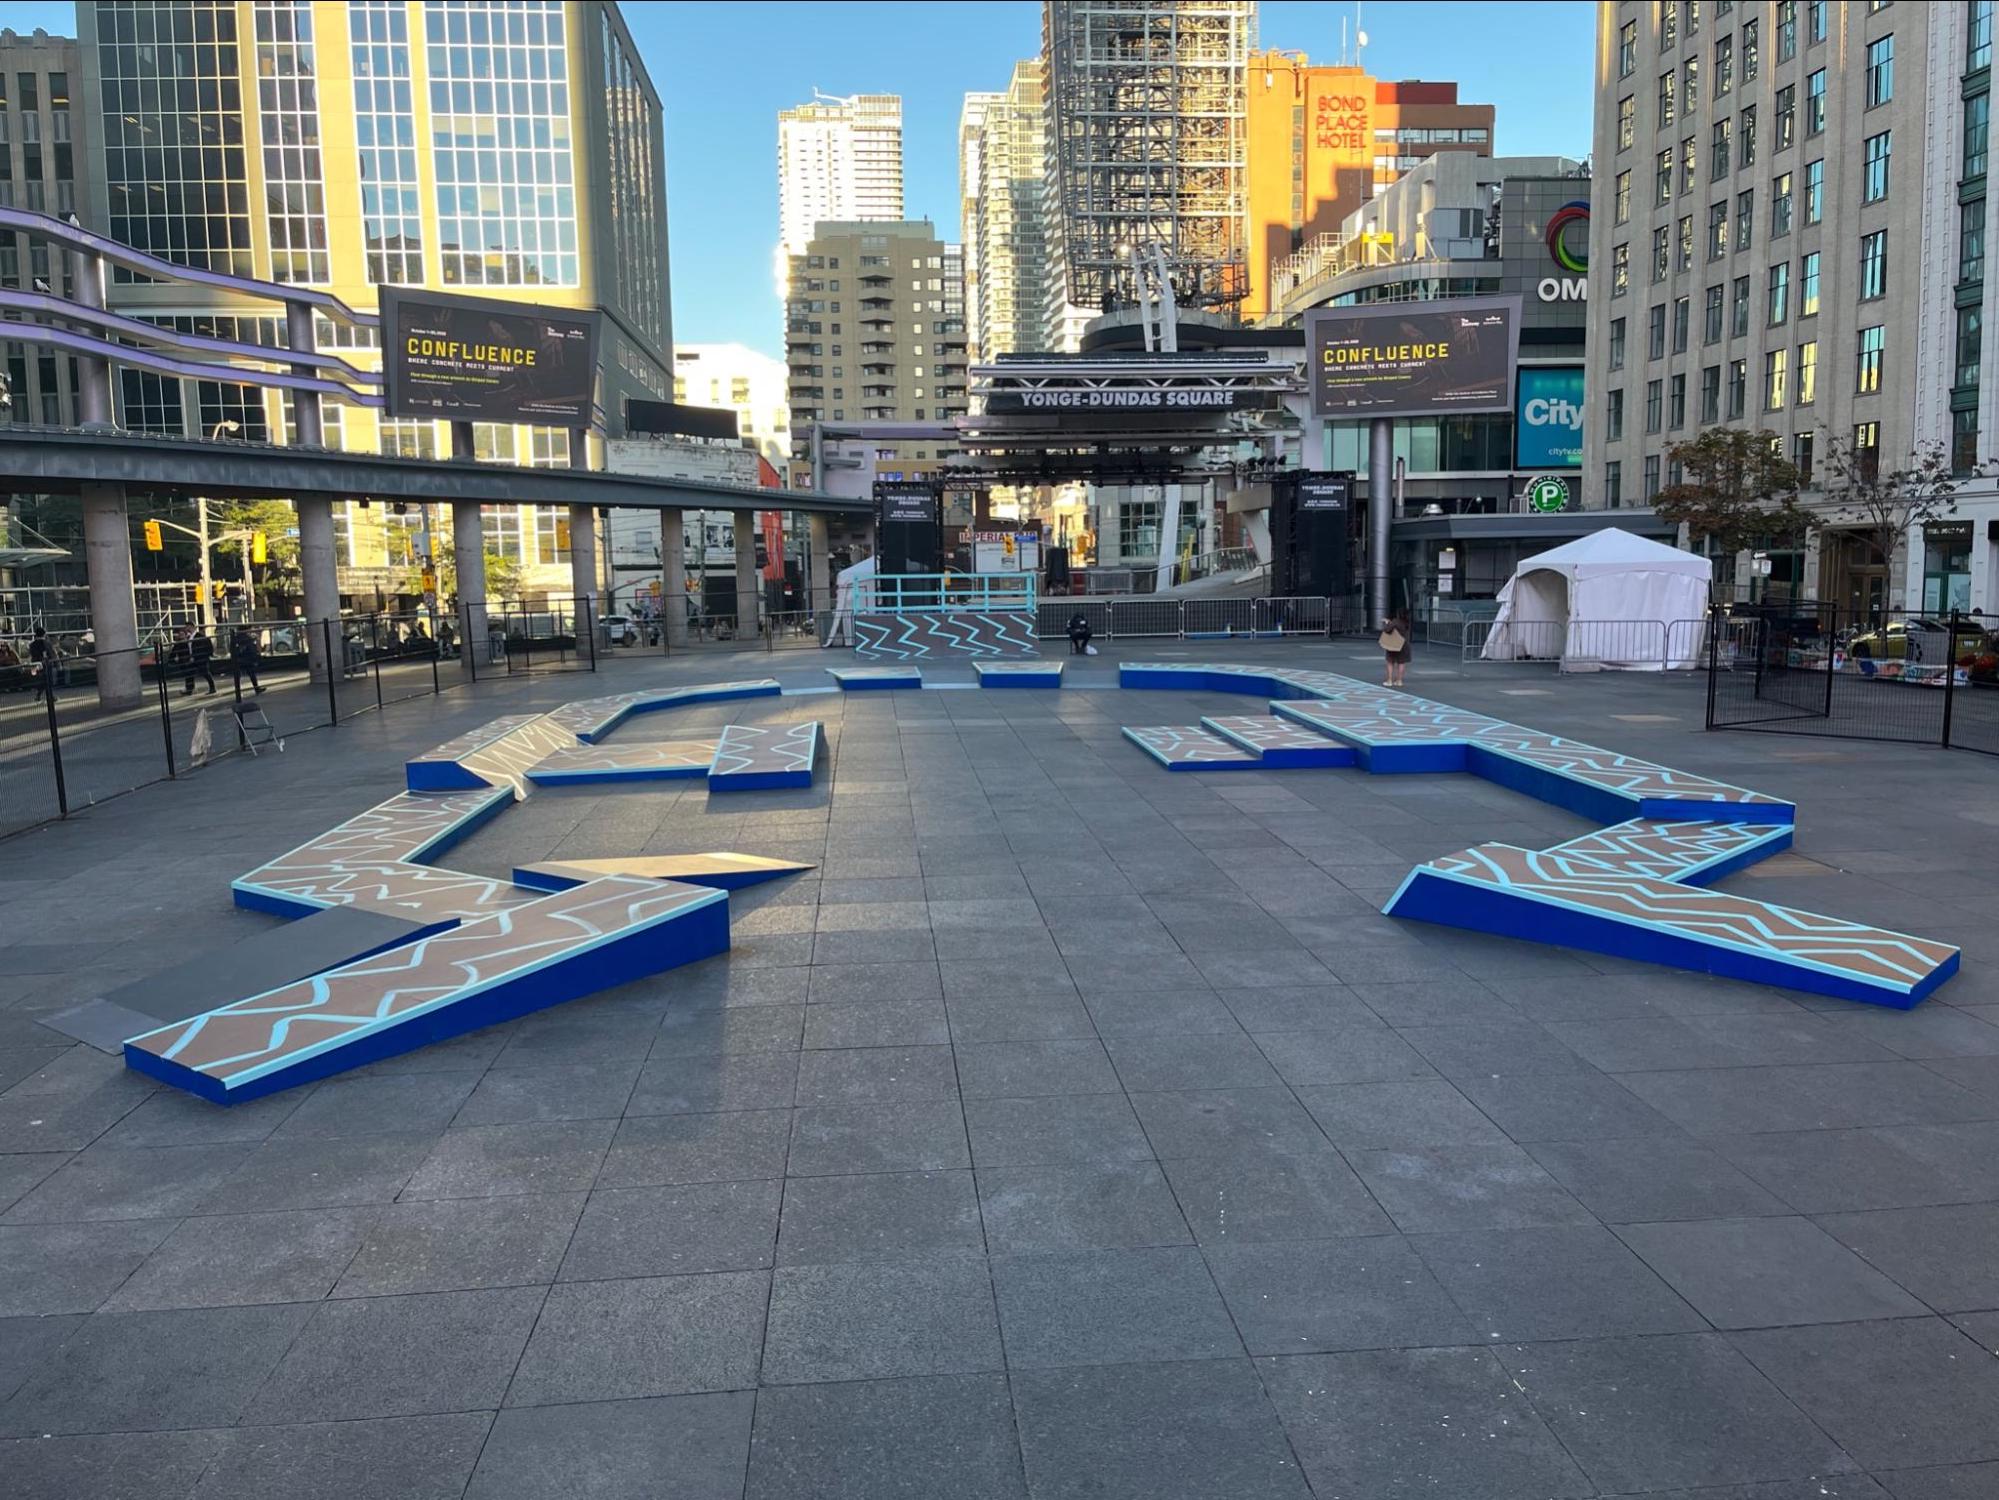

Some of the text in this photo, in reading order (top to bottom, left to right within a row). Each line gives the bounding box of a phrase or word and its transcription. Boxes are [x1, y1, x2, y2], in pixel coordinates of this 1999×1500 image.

[1318, 95, 1366, 112] BOND
[1316, 114, 1368, 131] PLACE
[1317, 132, 1367, 149] HOTEL
[407, 338, 537, 366] CONFLUENCE
[1324, 343, 1450, 364] CONFLUENCE
[408, 357, 515, 372] WHERE CONCRETE MEETS CURRENT
[1020, 391, 1234, 407] YONGE-DUNDAS SQUARE
[1524, 398, 1585, 430] City
[1542, 485, 1559, 504] P
